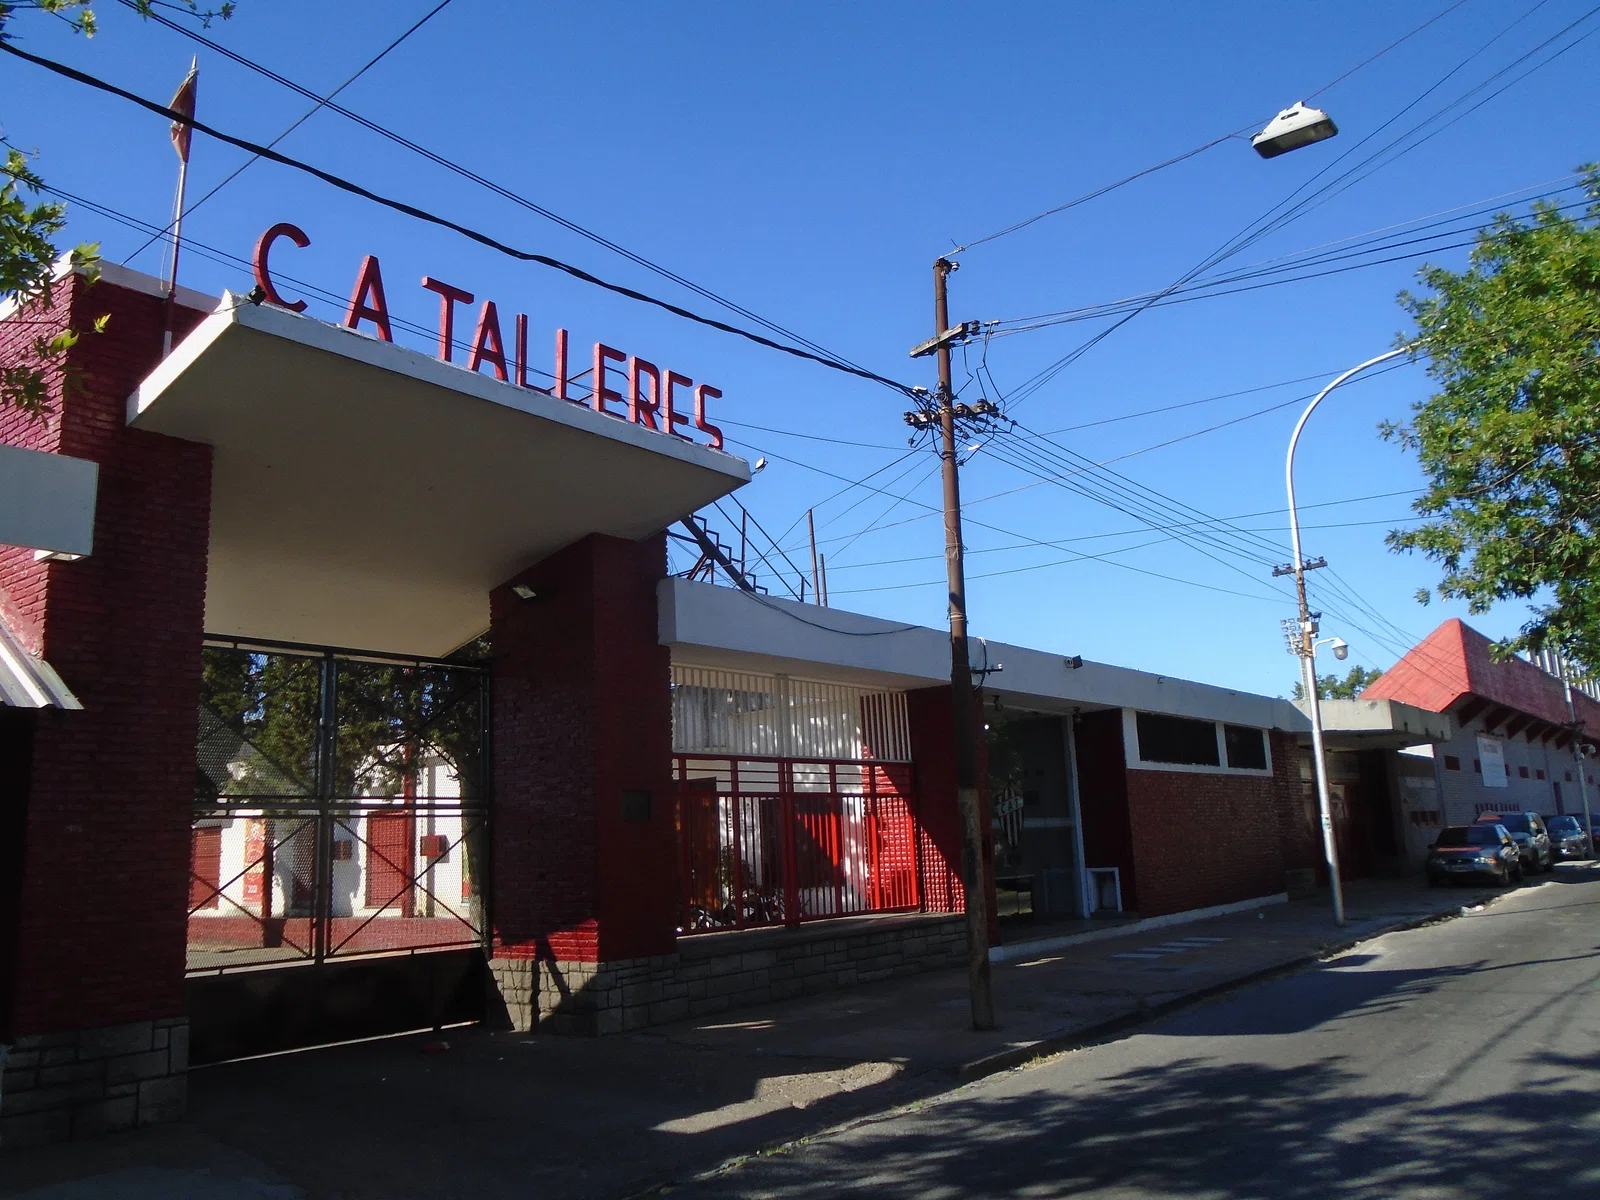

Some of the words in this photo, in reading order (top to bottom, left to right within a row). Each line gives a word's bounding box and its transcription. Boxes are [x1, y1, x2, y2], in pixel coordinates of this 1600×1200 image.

[252, 222, 311, 312] C
[343, 255, 393, 342] A
[421, 276, 724, 451] TALLERES
